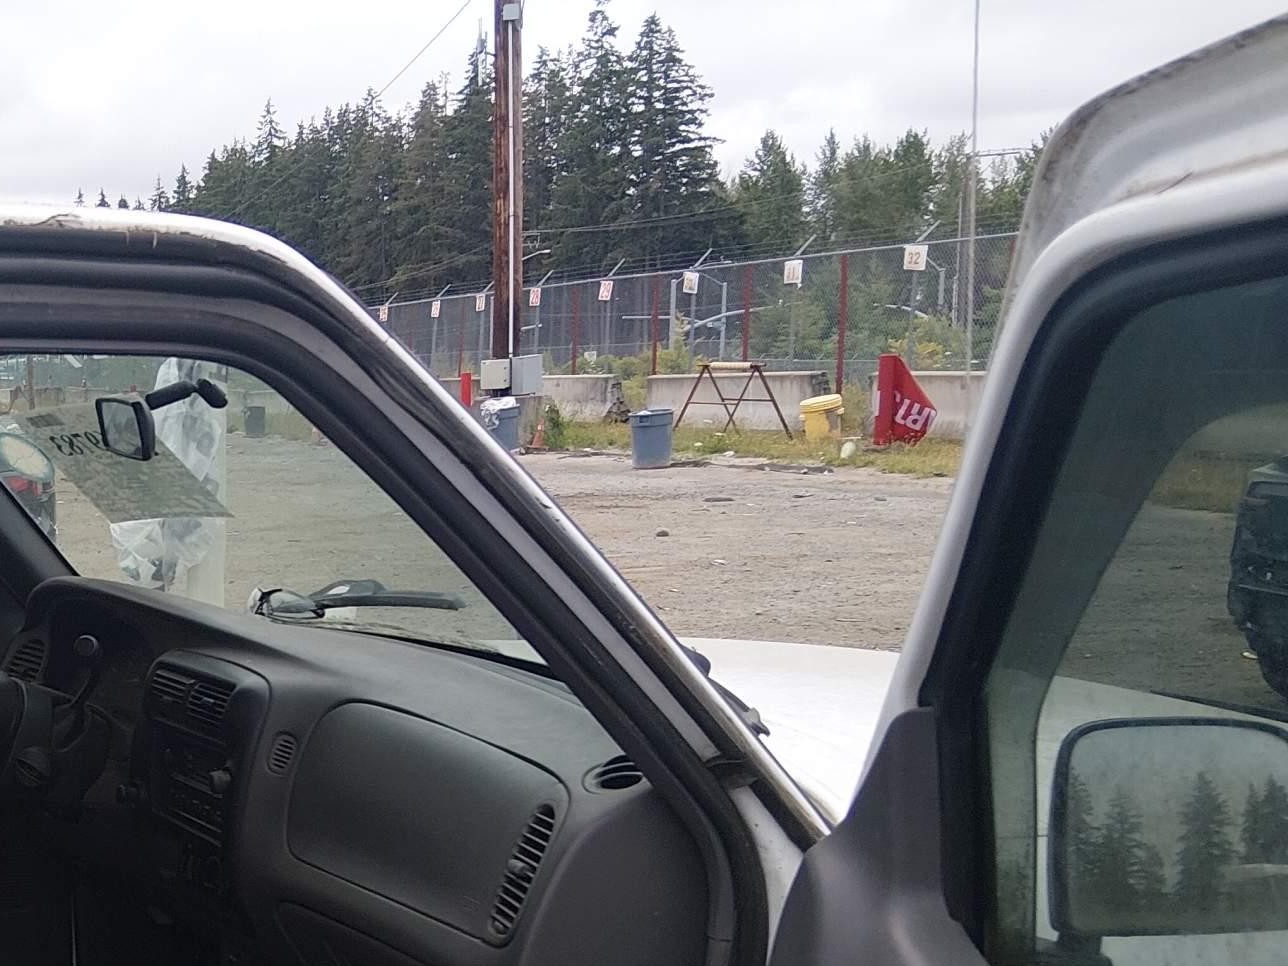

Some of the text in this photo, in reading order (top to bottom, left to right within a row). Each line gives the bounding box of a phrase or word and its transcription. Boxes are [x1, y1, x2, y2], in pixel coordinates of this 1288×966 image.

[907, 251, 921, 265] 32
[530, 288, 540, 305] 28
[599, 281, 611, 299] 29
